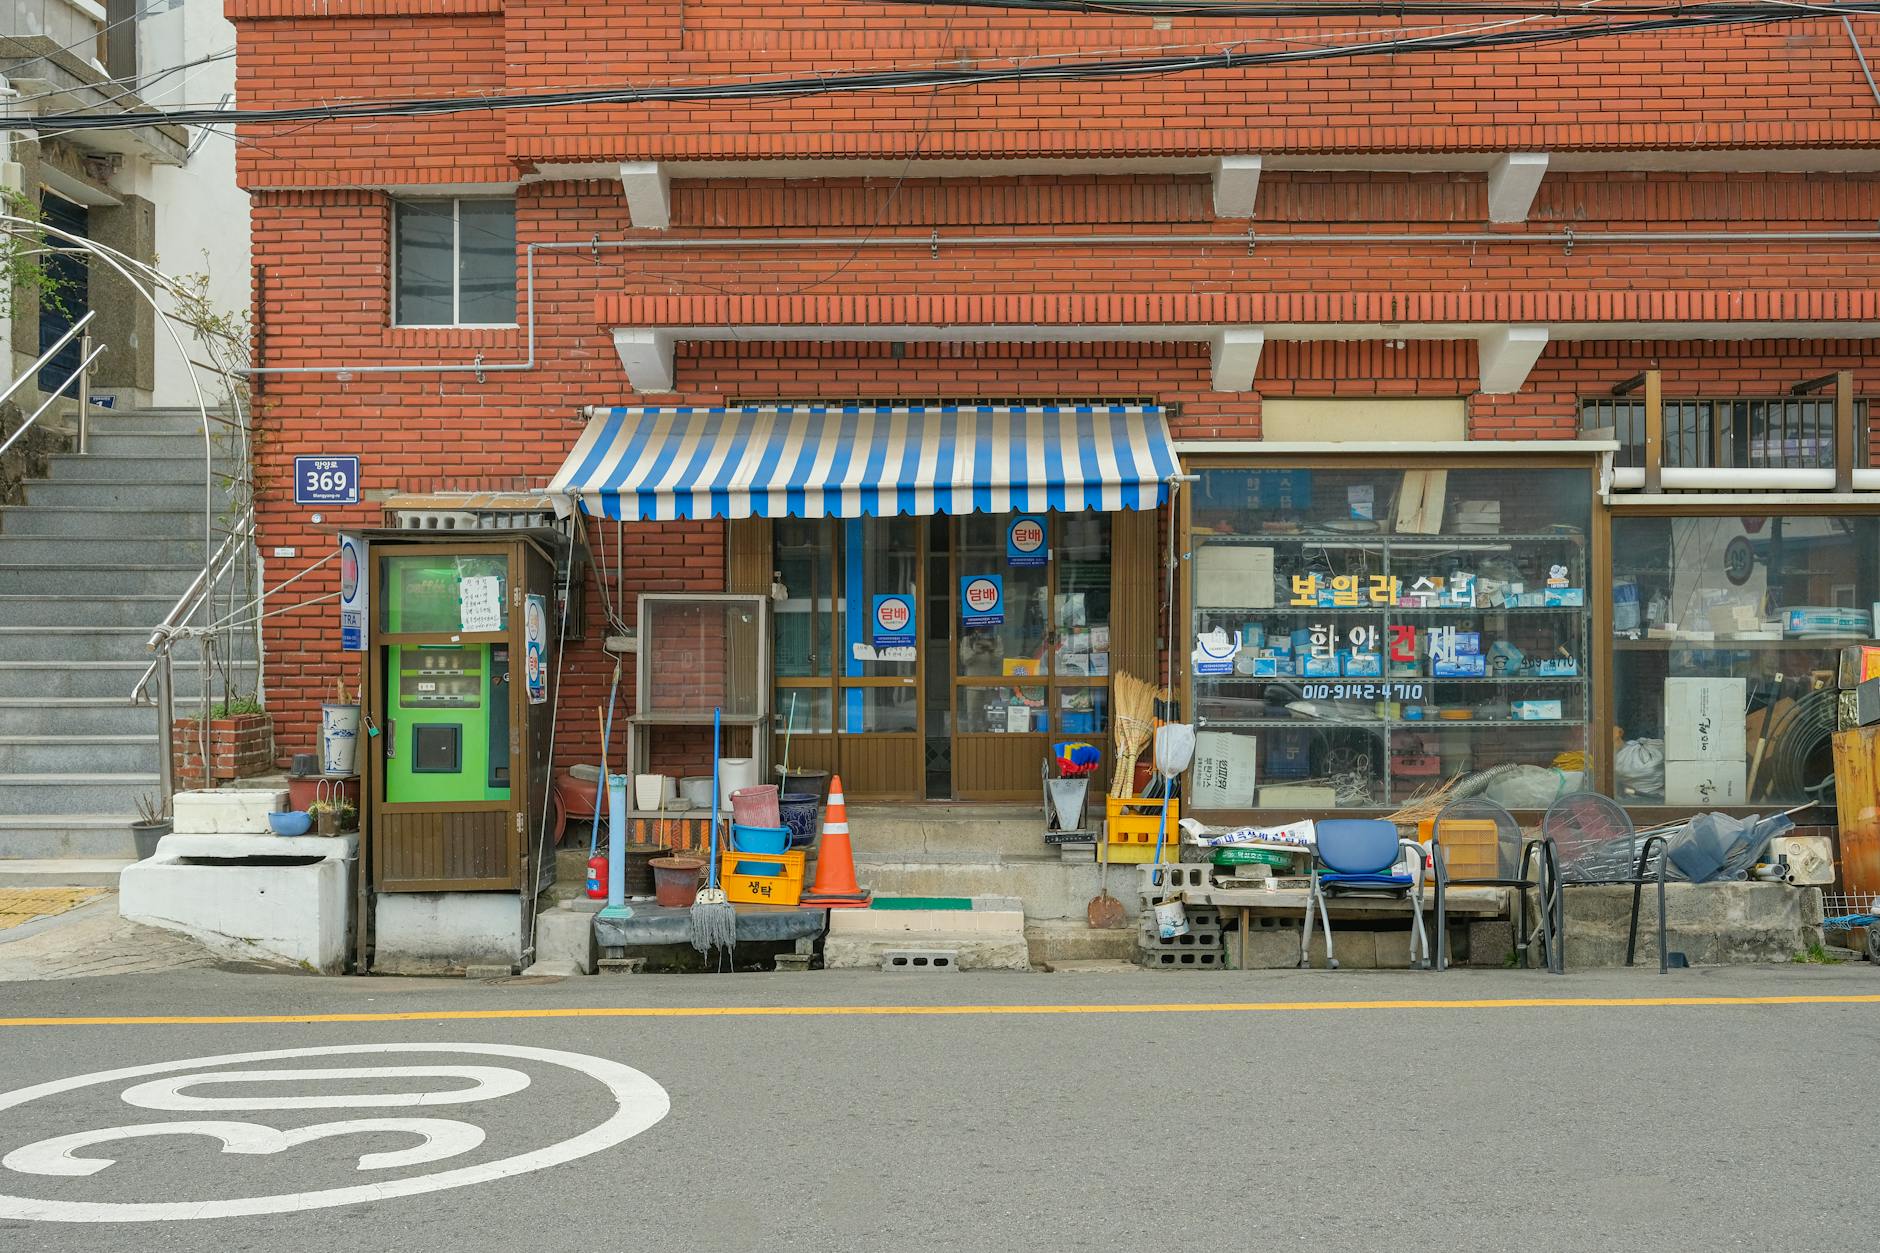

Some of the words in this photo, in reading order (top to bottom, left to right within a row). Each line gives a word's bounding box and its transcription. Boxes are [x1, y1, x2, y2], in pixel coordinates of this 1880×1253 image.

[315, 461, 338, 470] 망양로
[306, 471, 347, 491] 369
[1015, 529, 1041, 542] 담배
[969, 588, 996, 601] 담배
[880, 607, 907, 621] 담배
[748, 881, 773, 898] 생탁
